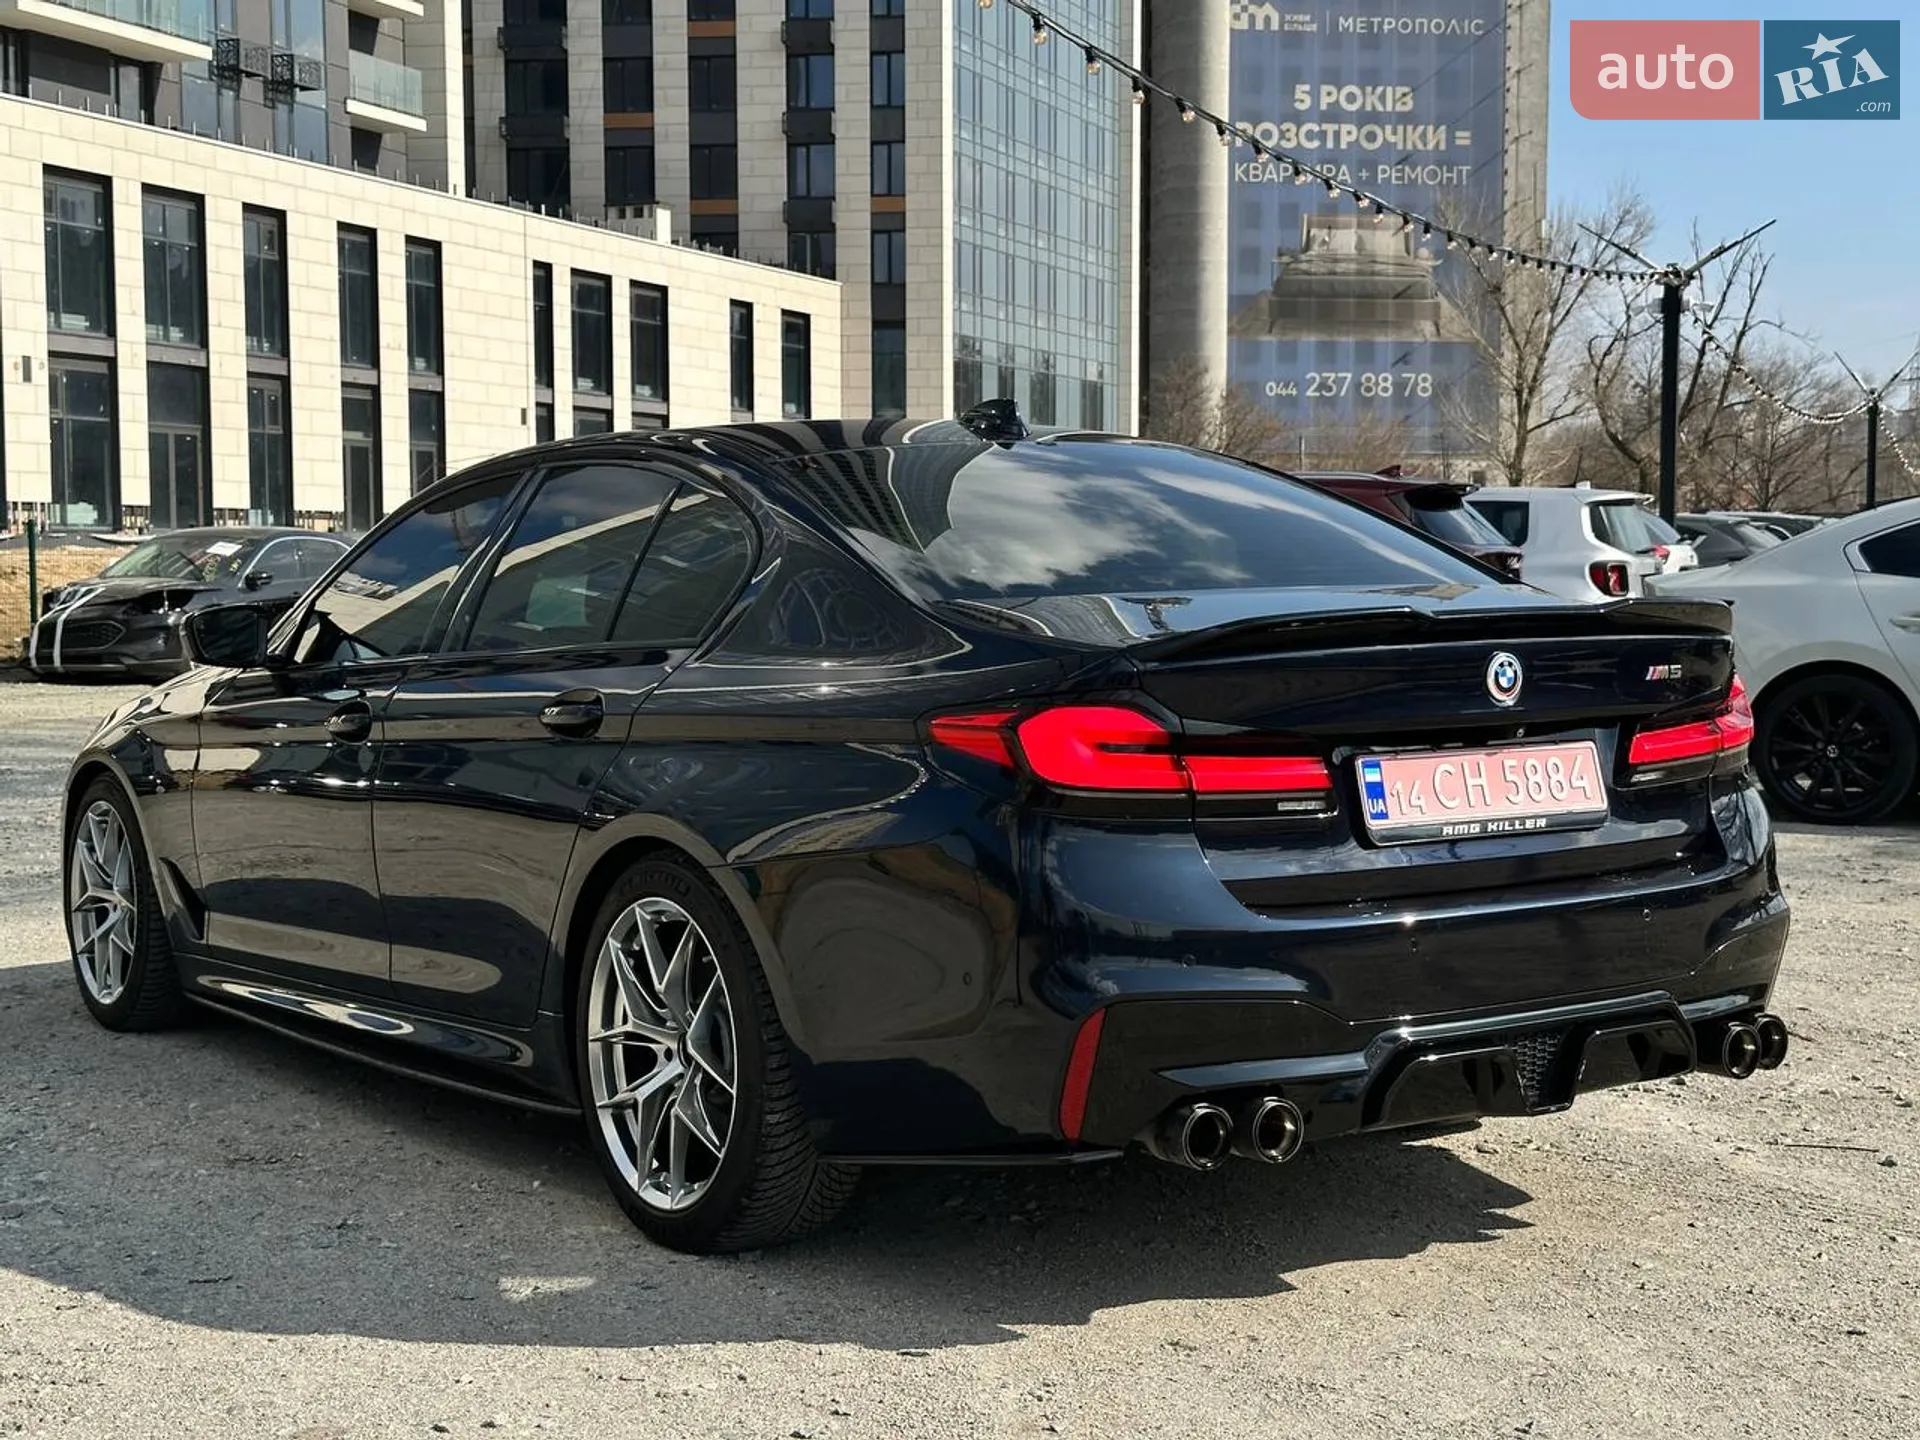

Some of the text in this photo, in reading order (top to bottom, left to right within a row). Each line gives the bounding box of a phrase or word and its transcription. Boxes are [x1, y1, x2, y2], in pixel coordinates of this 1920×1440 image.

[1338, 16, 1485, 35] МЕТРОПОЛІС
[1294, 84, 1415, 112] 5 РОКІВ
[1235, 121, 1447, 151] РОЗСТРОЧКИ
[1234, 163, 1352, 184] КВАРИРА
[1376, 165, 1471, 185] РЕМОНТ
[1265, 372, 1434, 398] 044 237 88 78
[1390, 779, 1427, 816] 14
[1502, 754, 1592, 805] 5884
[1369, 799, 1387, 815] UA
[1442, 817, 1547, 836] AMG KILLER
